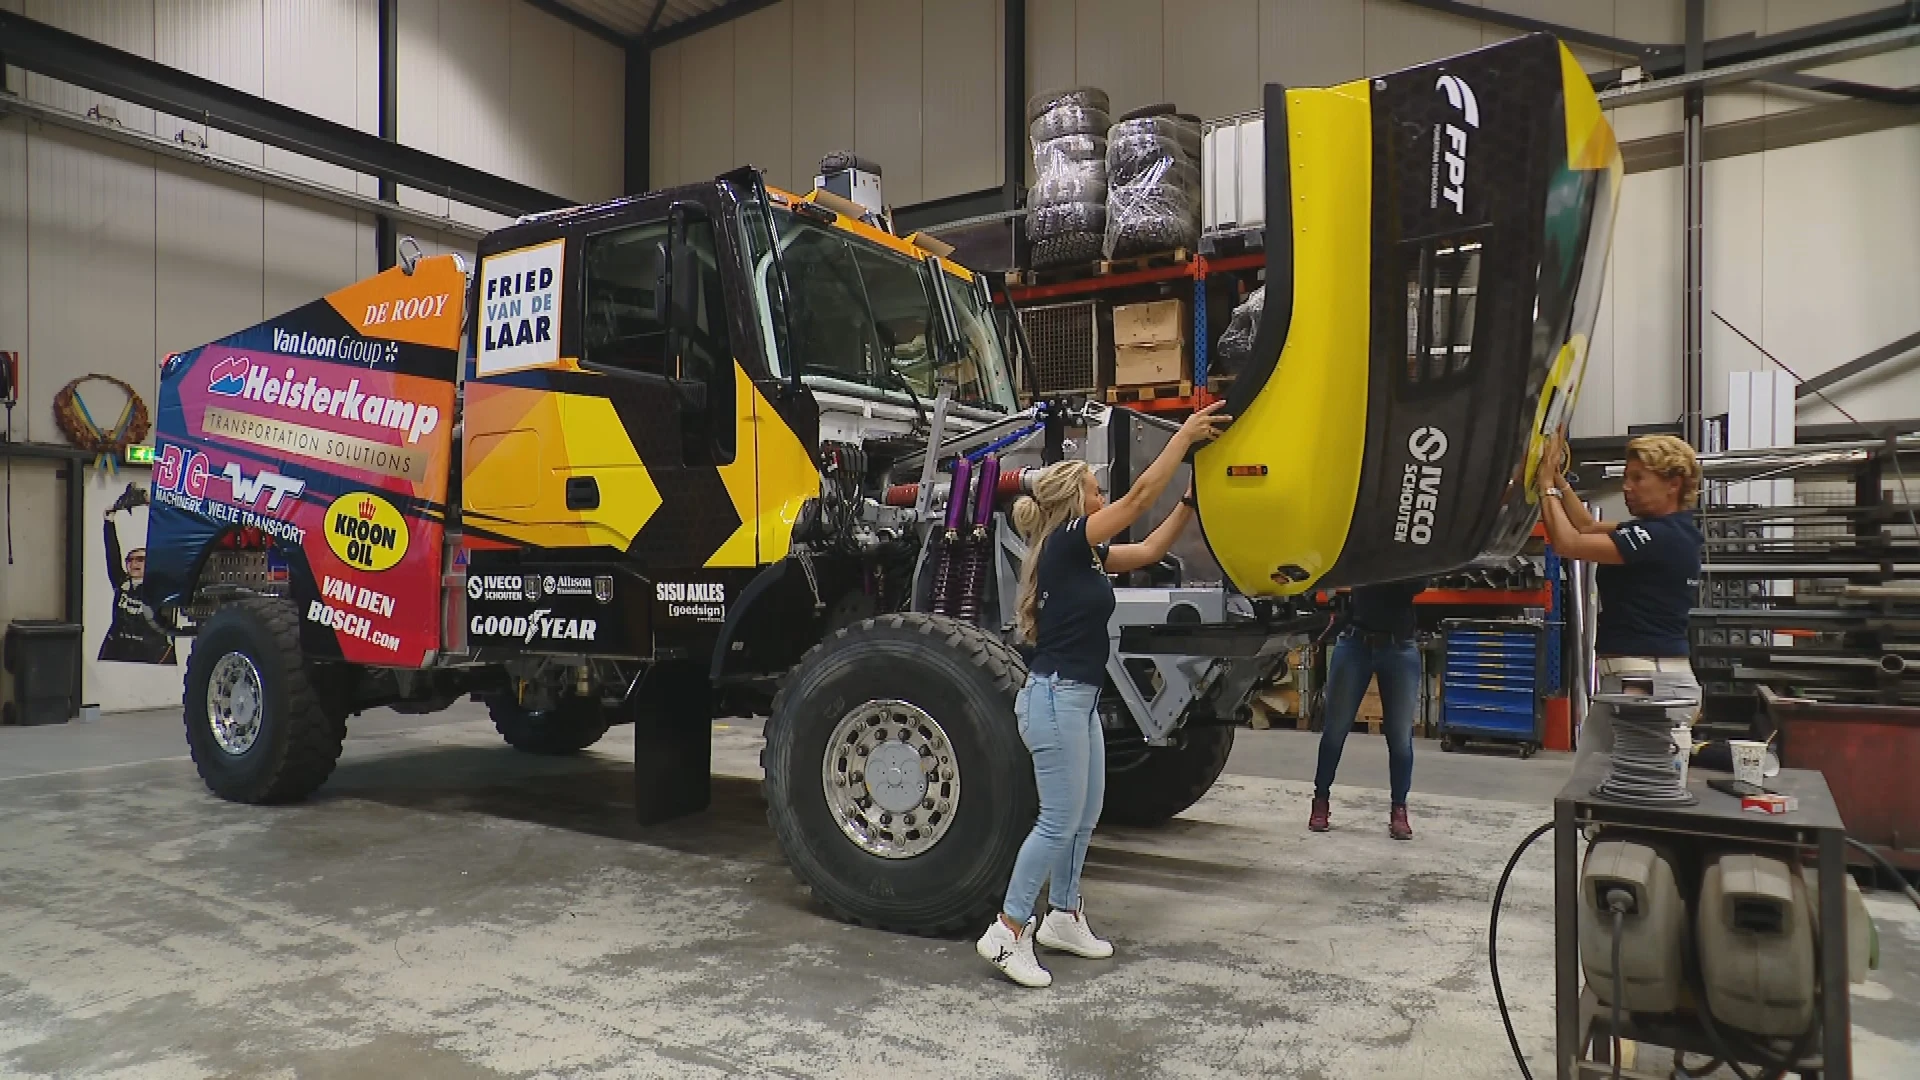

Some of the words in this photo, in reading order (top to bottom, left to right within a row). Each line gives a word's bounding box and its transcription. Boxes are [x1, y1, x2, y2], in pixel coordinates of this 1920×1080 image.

[1442, 123, 1467, 215] FPT
[487, 267, 553, 300] FRIED
[362, 302, 390, 326] DE
[391, 293, 449, 321] ROOY
[487, 300, 521, 321] VAN
[531, 293, 552, 314] DE
[485, 315, 551, 351] LAAR
[338, 335, 382, 370] Group
[243, 363, 439, 444] Heisterkamp
[210, 412, 320, 451] TRANSPORTATION
[326, 439, 411, 473] SOLUTIONS
[156, 443, 209, 501] BIG
[221, 461, 306, 513] WT
[1393, 463, 1419, 543] SCHOUTEN
[1410, 465, 1443, 545] IVECO
[208, 501, 240, 524] WELTE
[241, 510, 306, 546] TRANSPORT
[334, 513, 397, 550] KROON
[346, 539, 373, 566] OIL
[322, 575, 356, 605] VAN
[356, 587, 396, 619] DEN
[484, 575, 522, 589] IVECO
[484, 590, 522, 601] SCHOUTEN
[556, 575, 592, 587] Allison
[656, 582, 685, 601] SISU
[686, 582, 725, 602] AXLES
[471, 607, 597, 643] GOODYEAR
